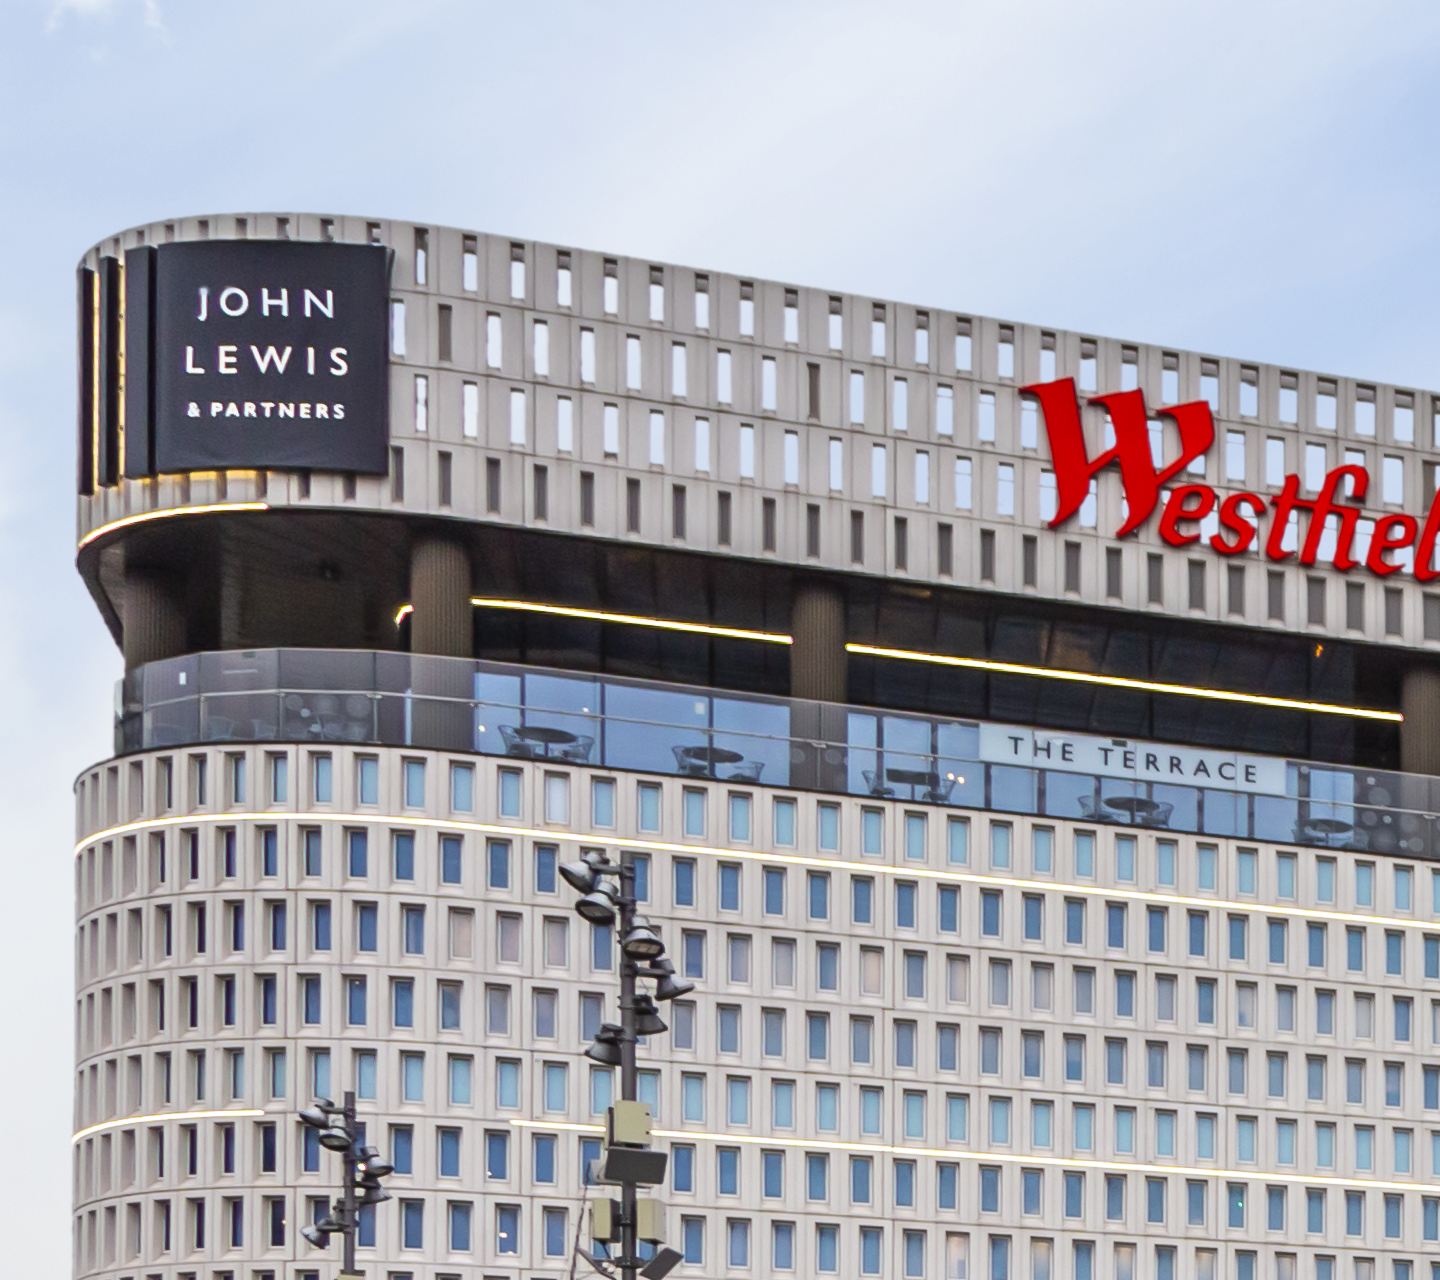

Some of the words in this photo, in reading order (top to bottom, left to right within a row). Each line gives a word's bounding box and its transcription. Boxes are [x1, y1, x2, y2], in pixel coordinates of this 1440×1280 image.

[197, 286, 334, 321] JOHN
[185, 345, 349, 376] LEWIS
[187, 401, 201, 418] &
[210, 401, 345, 419] PARTNERS
[1007, 736, 1074, 762] THE
[1097, 747, 1257, 784] TERRACE
